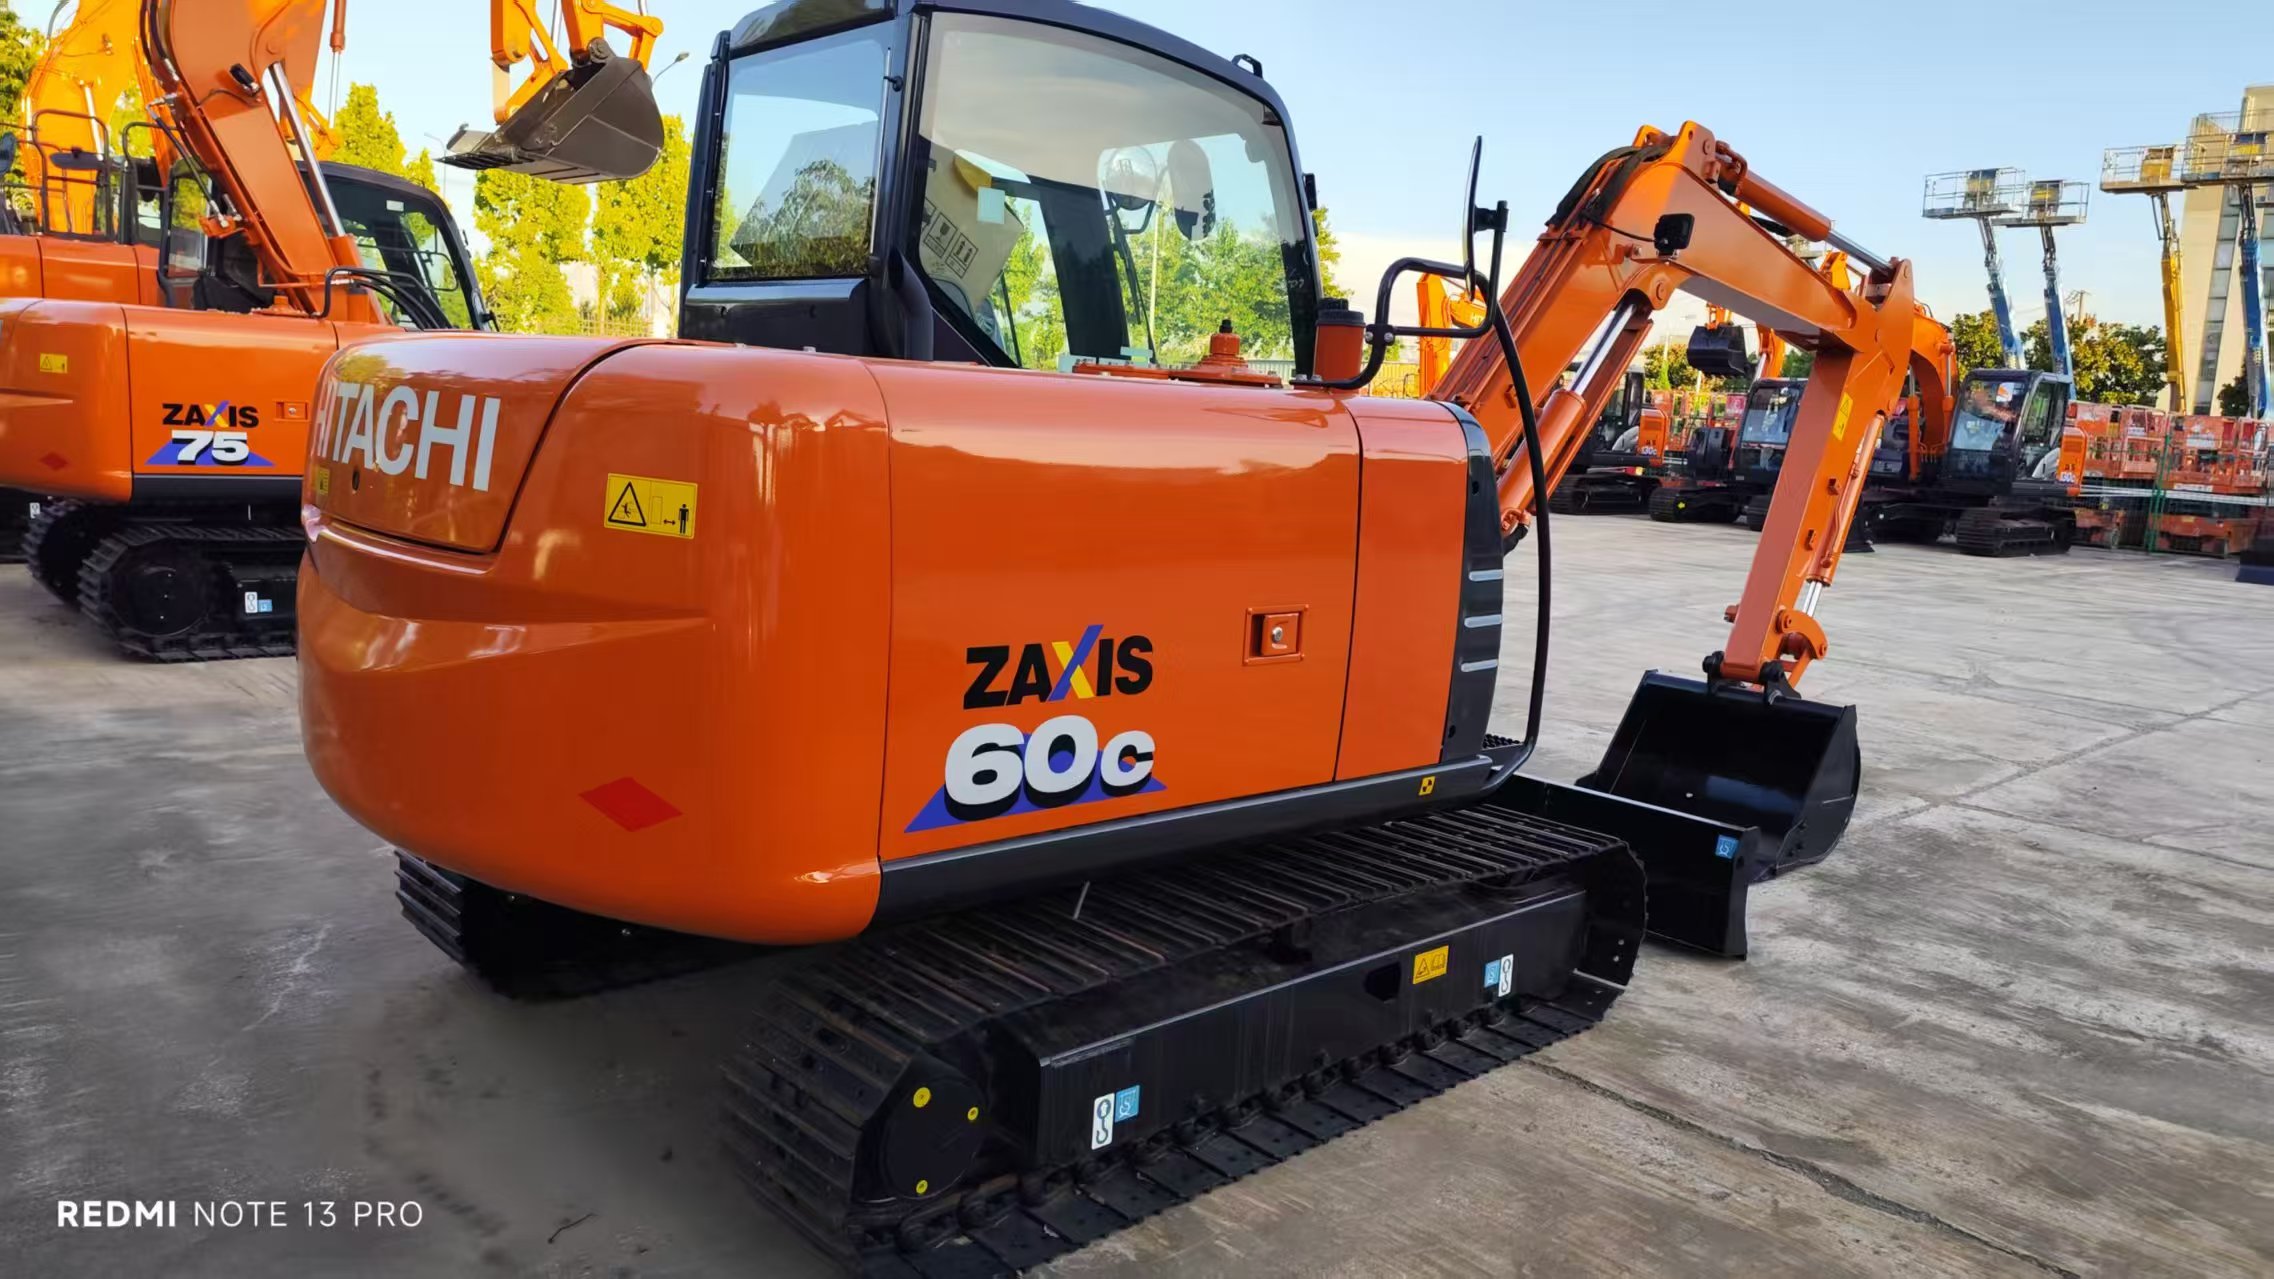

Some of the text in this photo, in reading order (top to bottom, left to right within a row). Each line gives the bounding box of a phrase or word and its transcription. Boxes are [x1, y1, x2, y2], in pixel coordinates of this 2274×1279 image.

[162, 400, 259, 428] ZAXIS
[312, 376, 502, 492] HITACHI
[171, 429, 250, 466] 75
[963, 624, 1153, 710] ZAXIS
